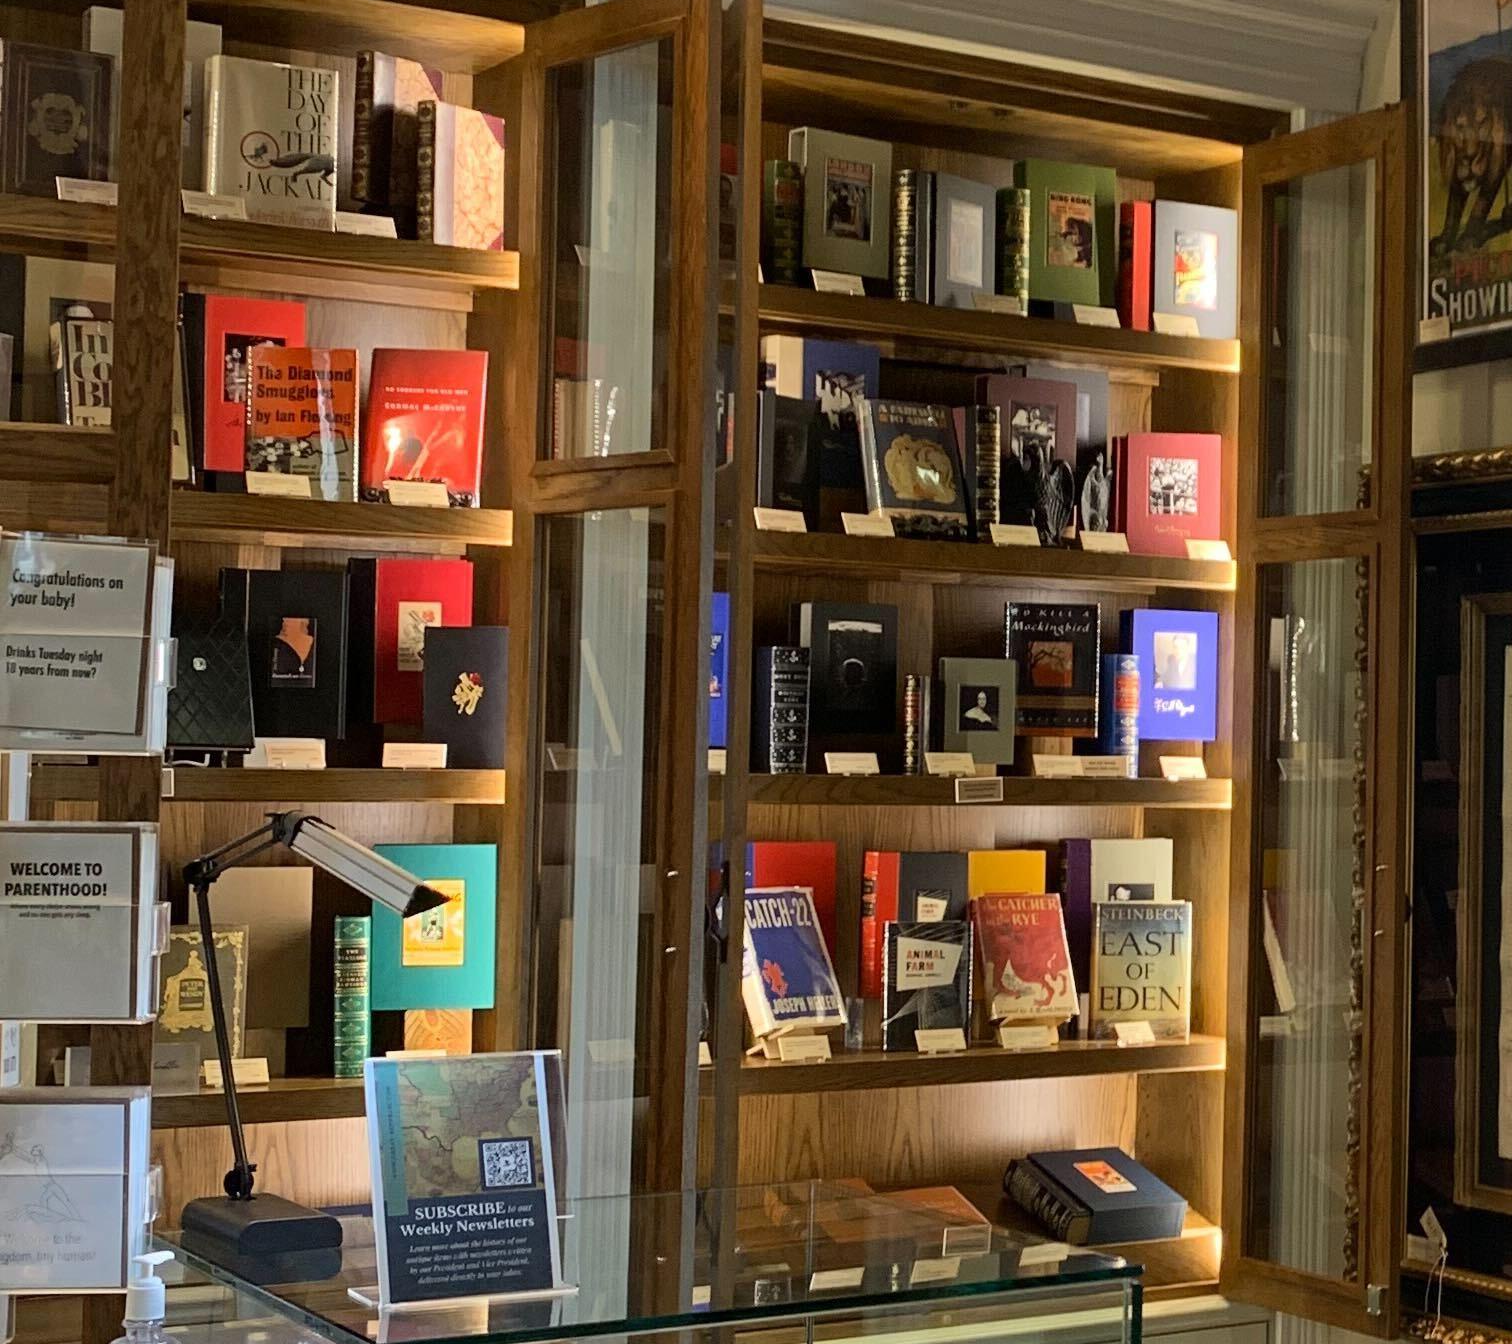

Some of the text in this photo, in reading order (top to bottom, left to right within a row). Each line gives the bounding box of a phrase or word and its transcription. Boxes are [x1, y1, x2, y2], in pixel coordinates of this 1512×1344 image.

[281, 68, 333, 94] THE
[287, 88, 326, 113] DAY
[296, 112, 331, 136] OF
[281, 130, 331, 155] THE
[239, 171, 332, 202] JACKAL
[256, 409, 271, 424] by
[275, 409, 296, 422] Ian
[108, 578, 123, 589] on
[10, 590, 75, 610] your baby!
[1011, 621, 1091, 637] Mockingbird
[6, 645, 103, 665] Drinks Tuesday night
[18, 664, 44, 678] years
[46, 664, 69, 677] from
[71, 666, 97, 679] now?
[10, 862, 103, 877] WELCOME TO
[4, 882, 107, 897] PARENTHOOD!
[745, 897, 812, 929] CATCH-22
[998, 898, 1059, 911] CATCHER
[1011, 913, 1040, 926] RYE
[1102, 907, 1184, 921] STEINBECK
[1101, 930, 1184, 957] EAST
[906, 949, 945, 960] ANIMAL
[906, 961, 935, 971] FARM
[1126, 962, 1155, 980] OF
[773, 997, 807, 1015] JOSEPH
[1100, 985, 1182, 1012] EDEN
[414, 1201, 506, 1220] SUBSCRIBE
[400, 1217, 535, 1237] Weekly Newsletters
